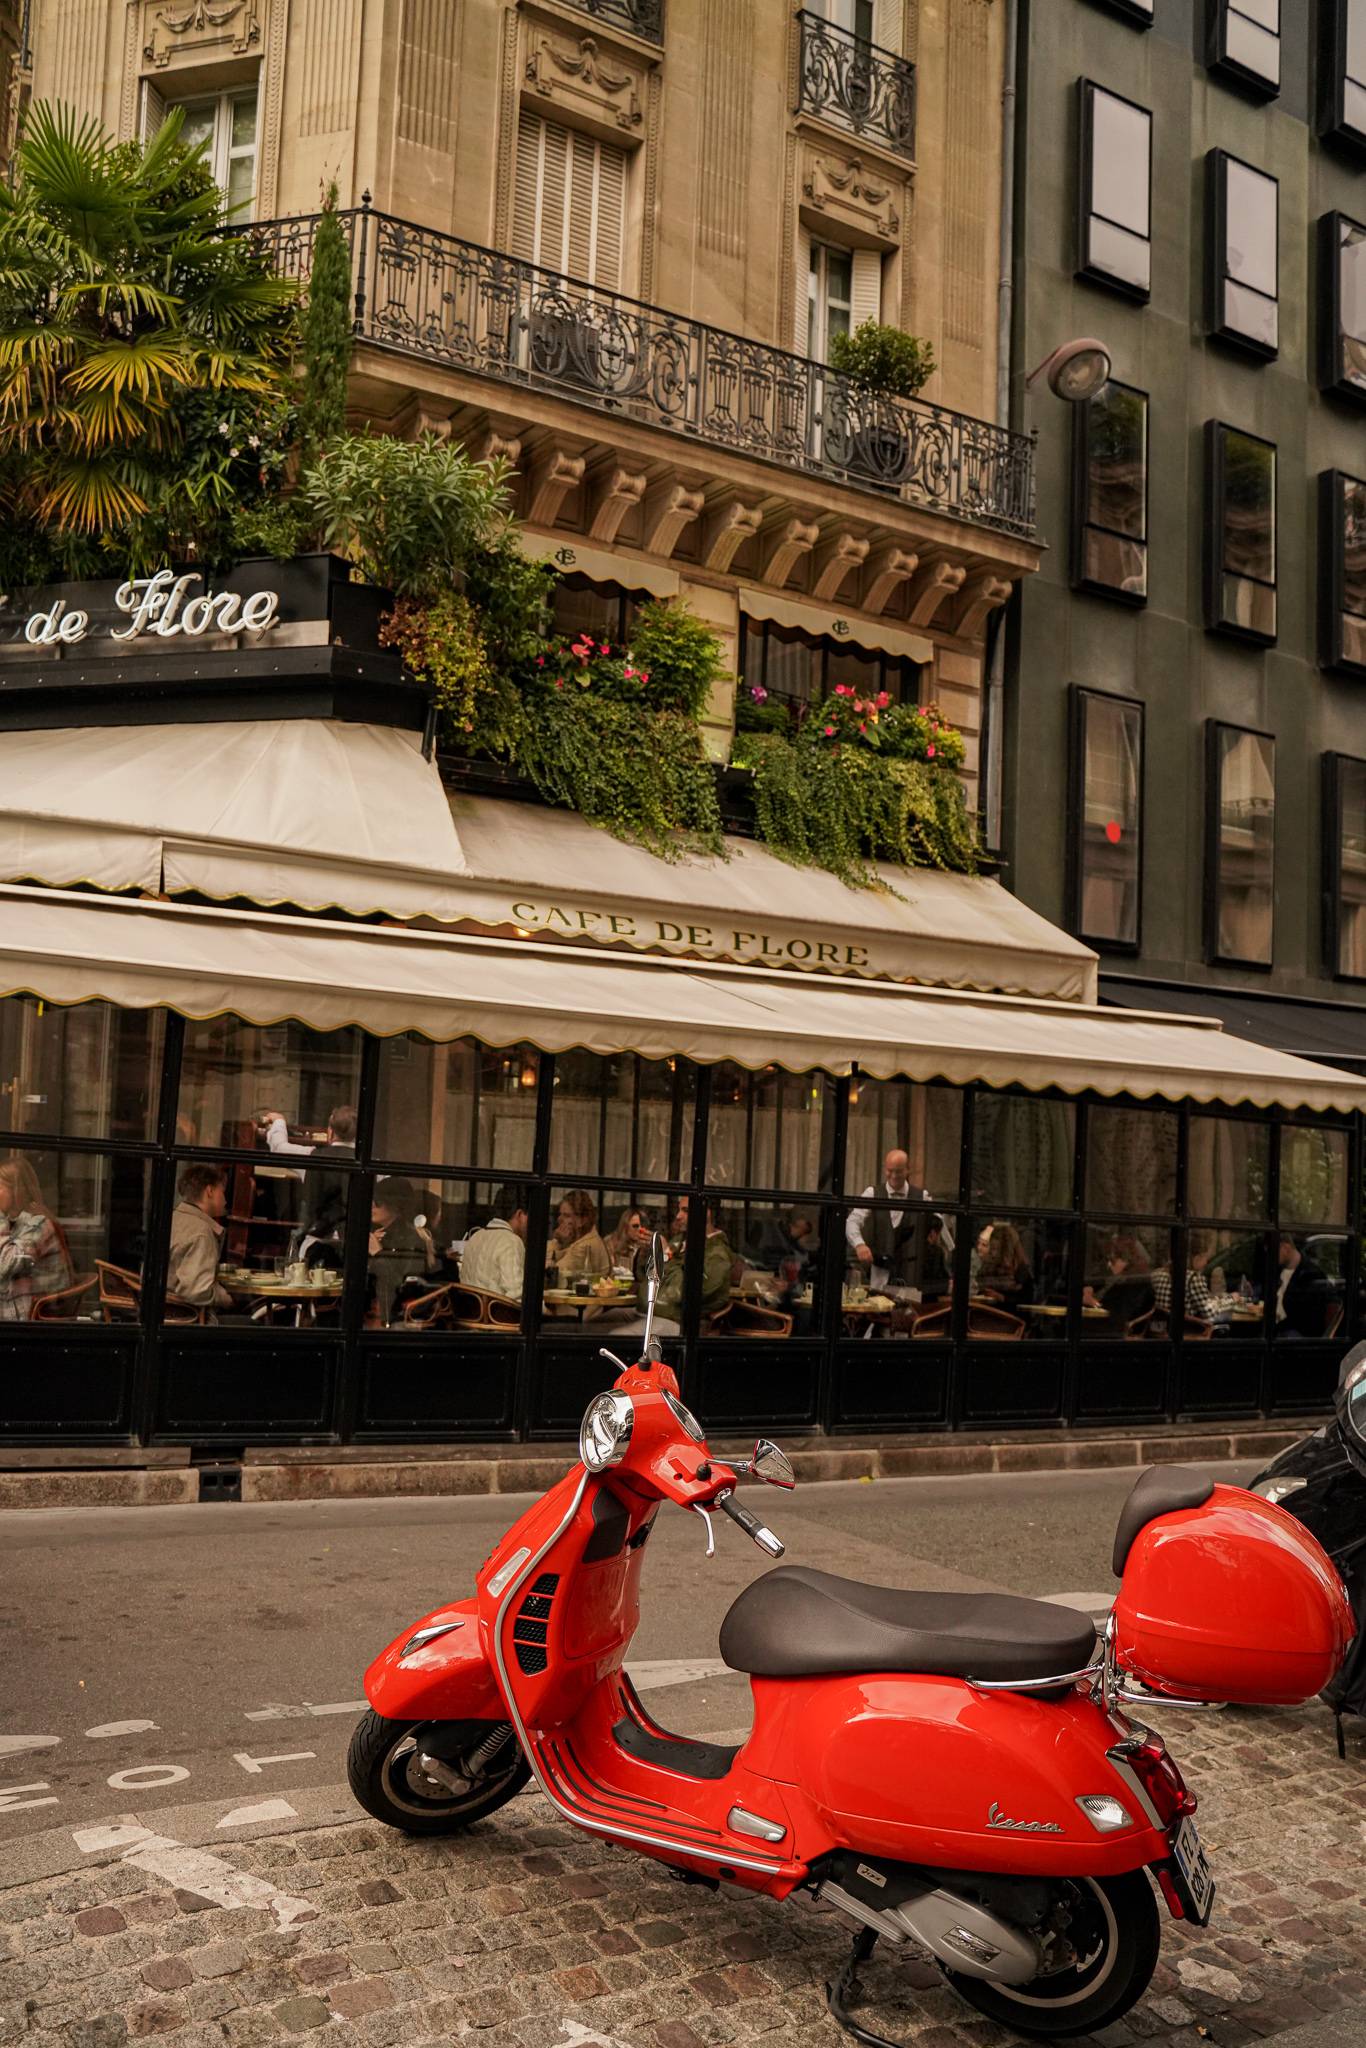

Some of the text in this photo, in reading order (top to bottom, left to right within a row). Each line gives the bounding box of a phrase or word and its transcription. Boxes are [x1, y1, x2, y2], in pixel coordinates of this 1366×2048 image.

[25, 569, 279, 645] de Flore
[511, 902, 870, 967] CAFE DE FLORE
[985, 1802, 1066, 1833] Vespa
